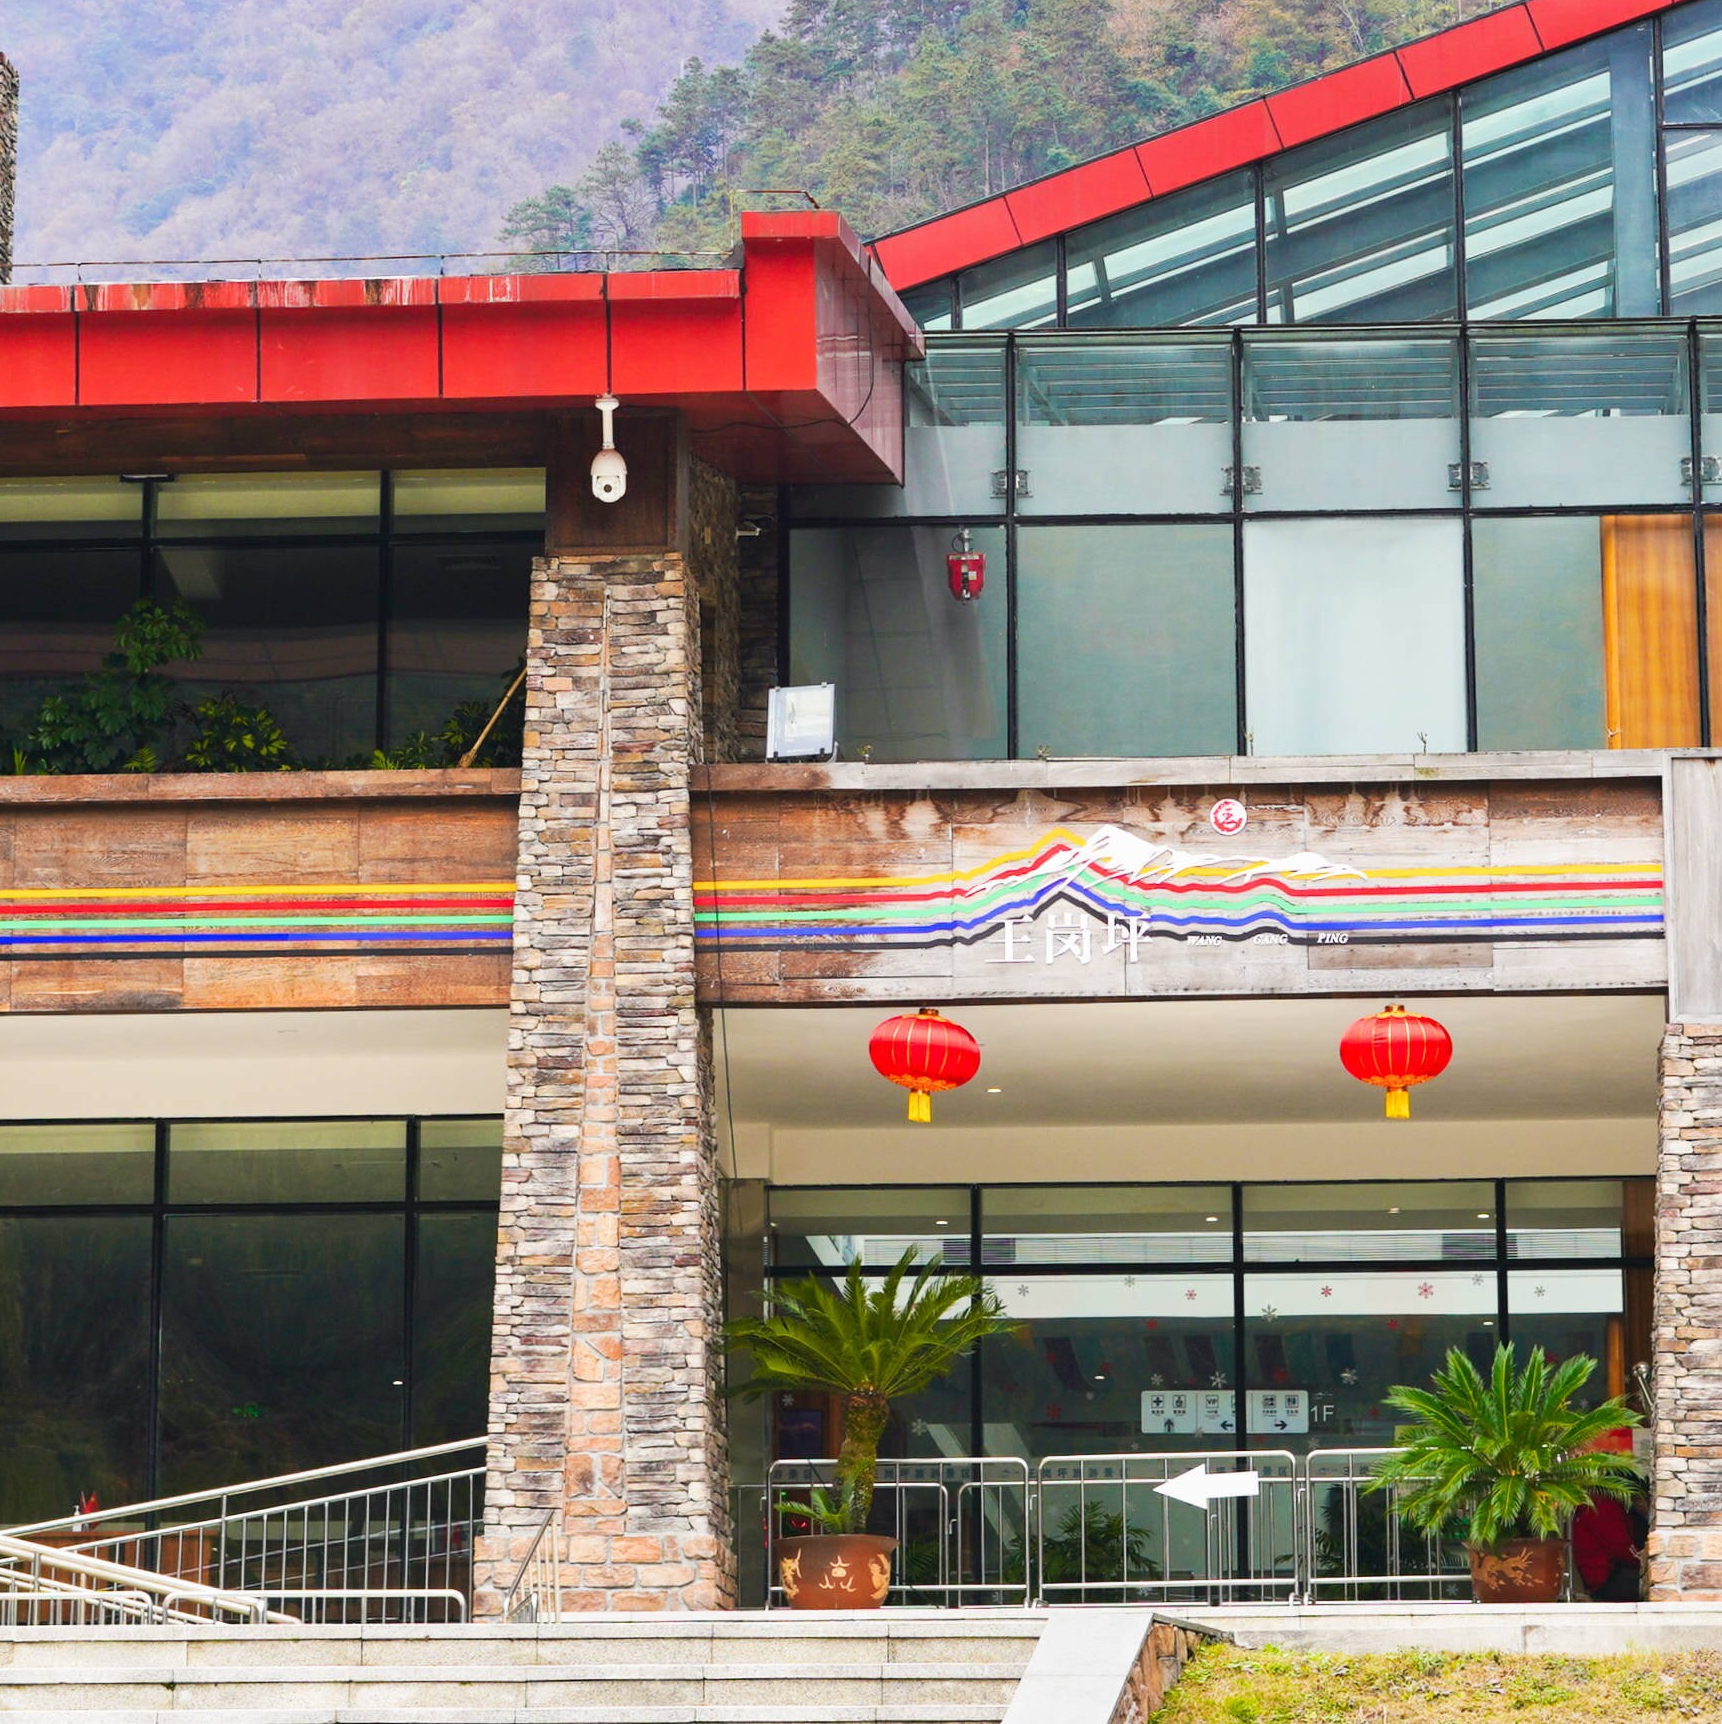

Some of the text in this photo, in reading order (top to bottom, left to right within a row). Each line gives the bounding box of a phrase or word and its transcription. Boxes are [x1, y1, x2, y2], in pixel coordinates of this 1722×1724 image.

[985, 913, 1153, 965] 王岗坪
[1187, 932, 1349, 946] WANG GANG PING
[1310, 1405, 1334, 1423] 1F
